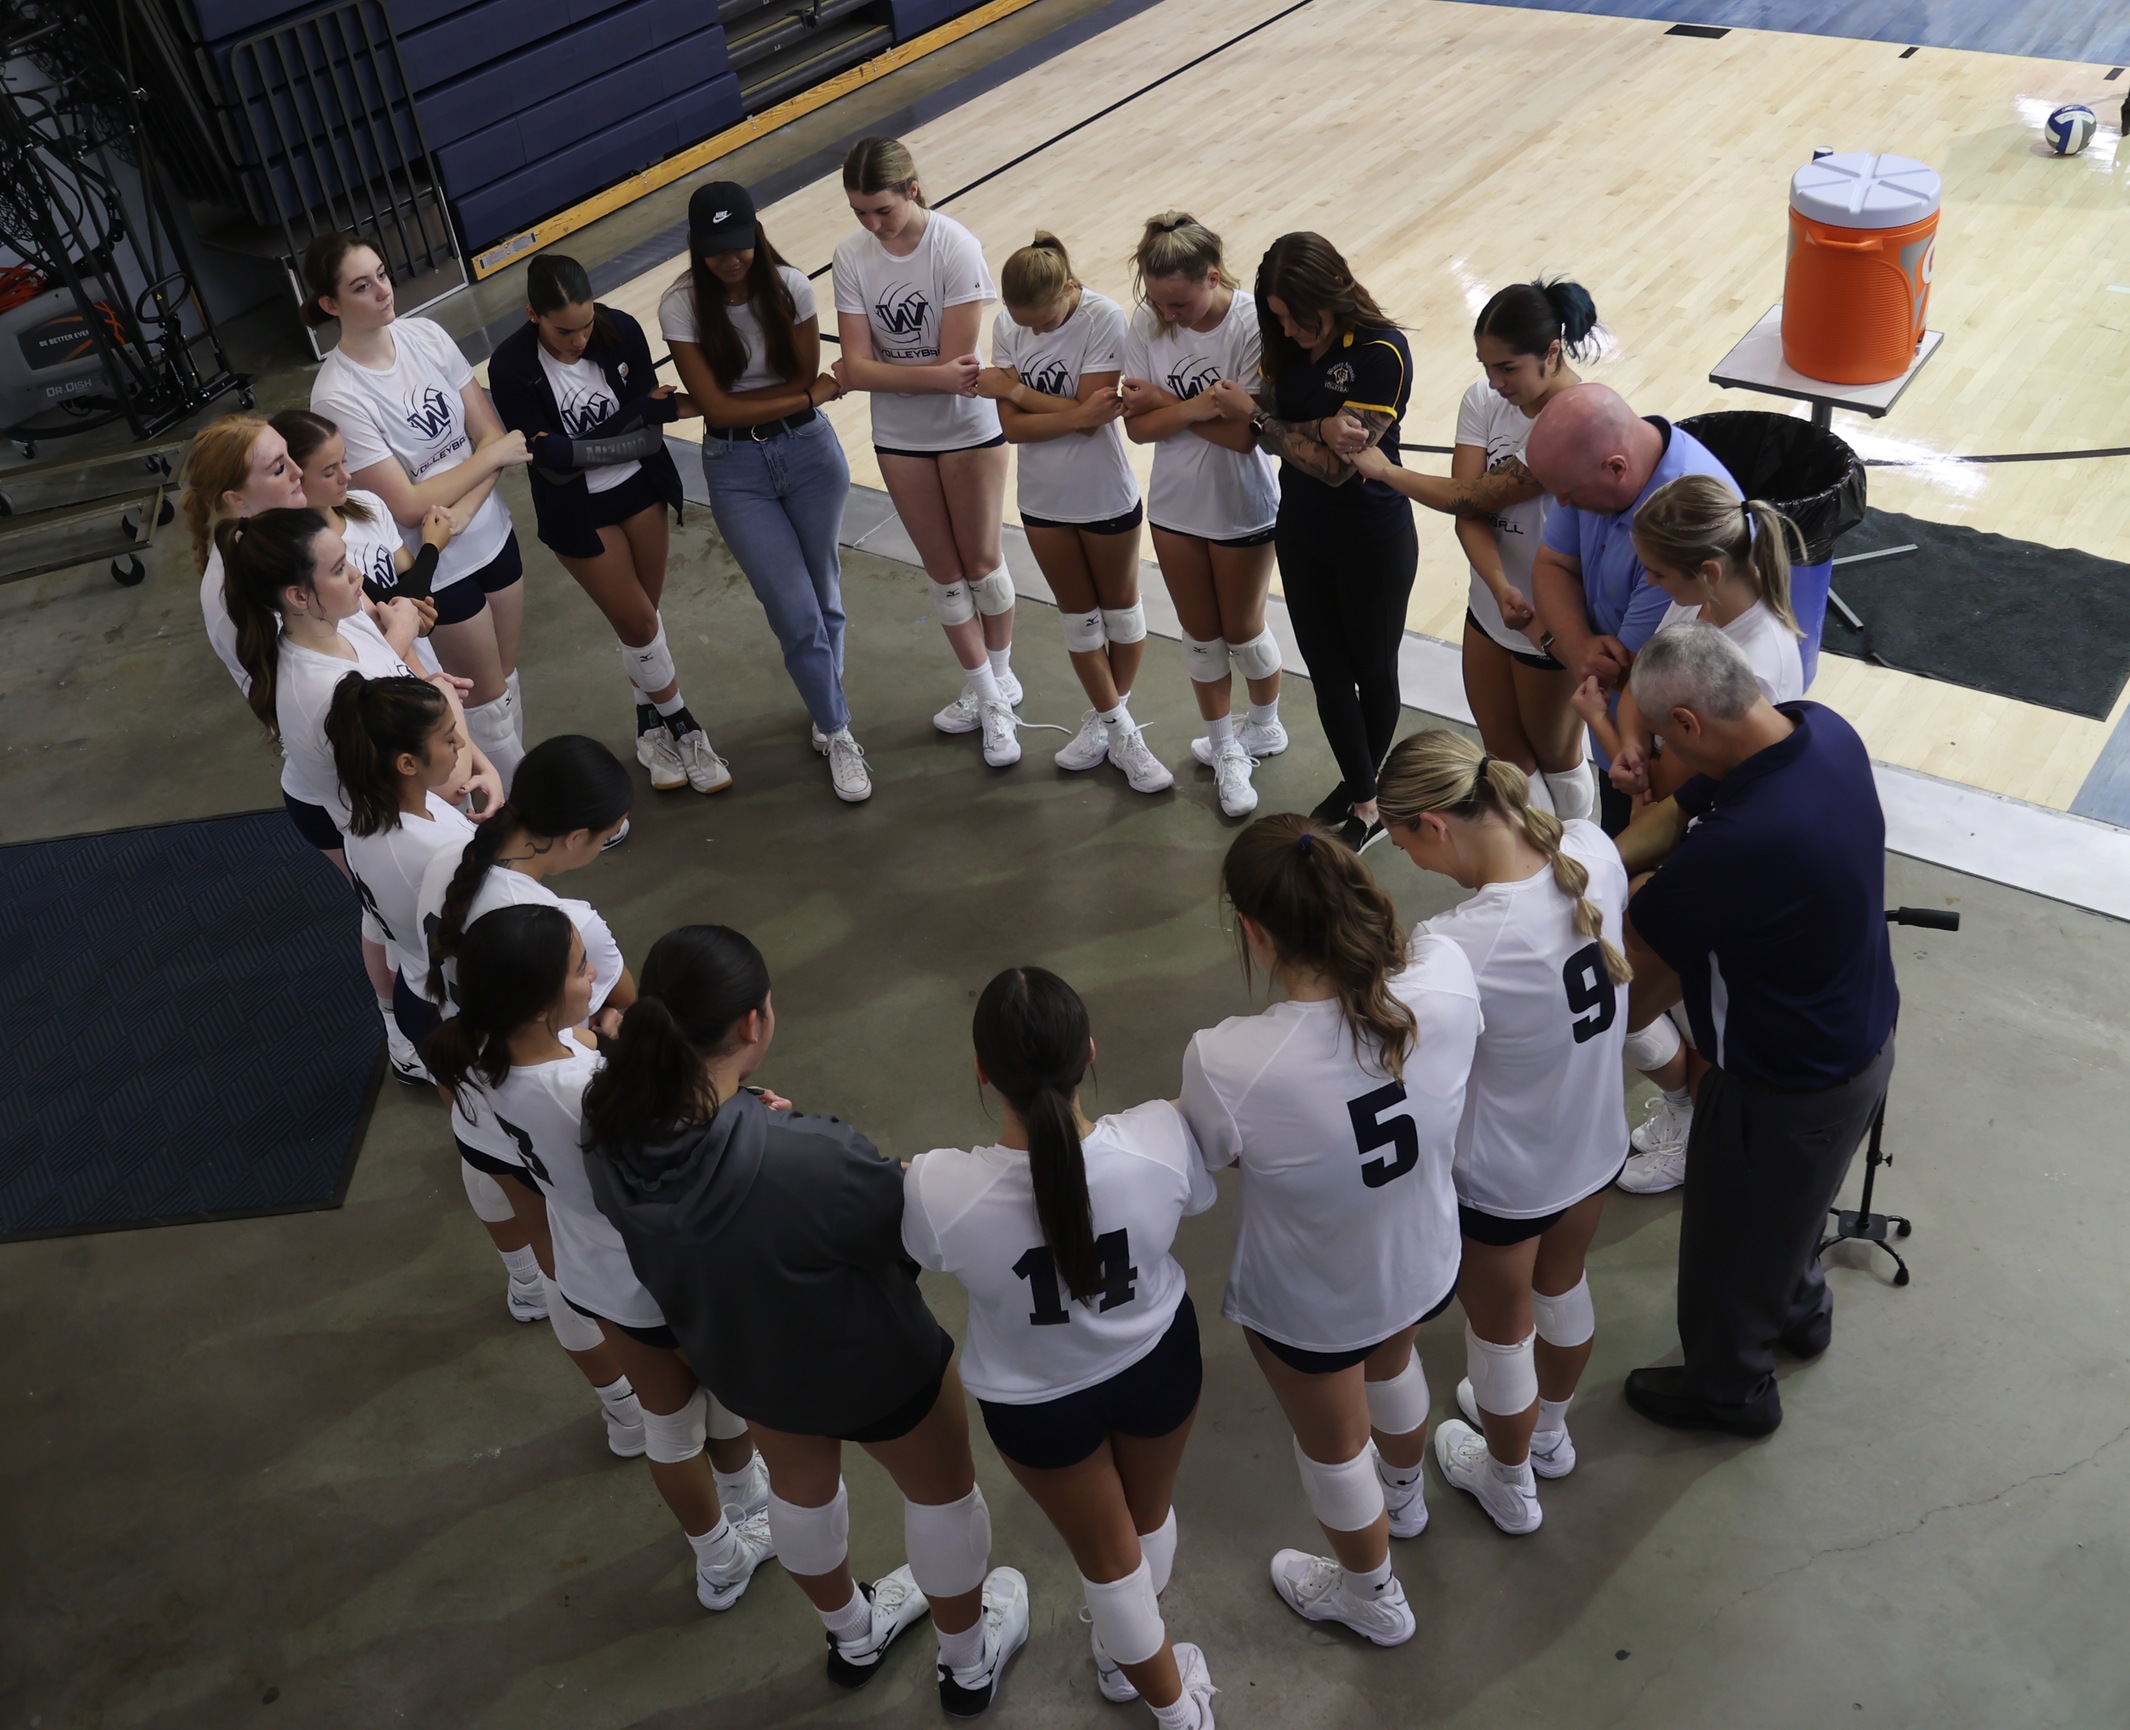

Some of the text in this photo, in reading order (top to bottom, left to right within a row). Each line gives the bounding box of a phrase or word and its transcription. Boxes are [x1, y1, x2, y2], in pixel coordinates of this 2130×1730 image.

[48, 333, 73, 345] BETTER
[875, 301, 929, 333] W
[406, 391, 451, 439] W
[1562, 941, 1617, 1044] 9
[1346, 1079, 1419, 1188] 5
[1011, 1227, 1138, 1326] 14
